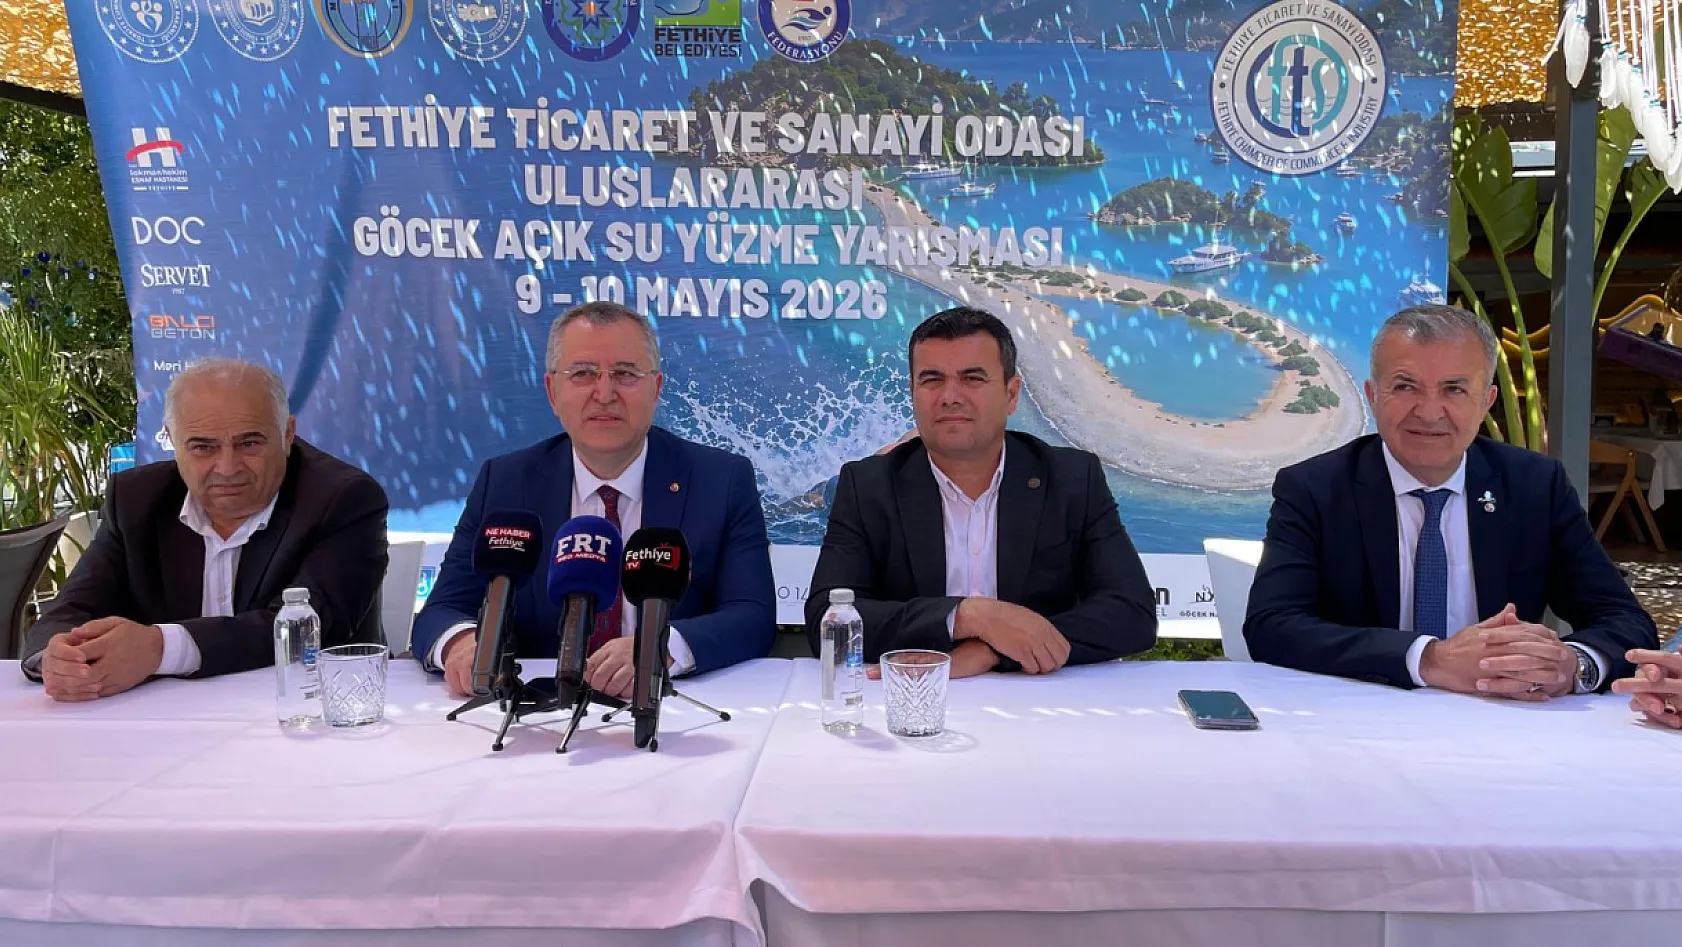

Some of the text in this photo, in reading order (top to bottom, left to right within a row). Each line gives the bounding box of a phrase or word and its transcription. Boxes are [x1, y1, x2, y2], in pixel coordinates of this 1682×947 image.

[1305, 3, 1321, 16] VE
[767, 31, 843, 60] FEDERASYONU
[327, 93, 1085, 158] FETHİYE TİCARET VE SANAYİ ODASI
[524, 163, 864, 211] ULUSLARARASI
[131, 216, 206, 245] DOC
[353, 205, 1064, 279] GÖCEK AÇIK SU YÜZME YARIŞMASI
[140, 263, 211, 288] SERVET
[515, 273, 542, 315] 9
[581, 275, 625, 307] 10
[637, 276, 770, 318] MAYIS
[780, 279, 889, 320] 2026
[150, 328, 217, 340] BETON
[556, 533, 612, 558] FRT
[626, 548, 671, 562] Fethiye
[626, 561, 640, 569] TV
